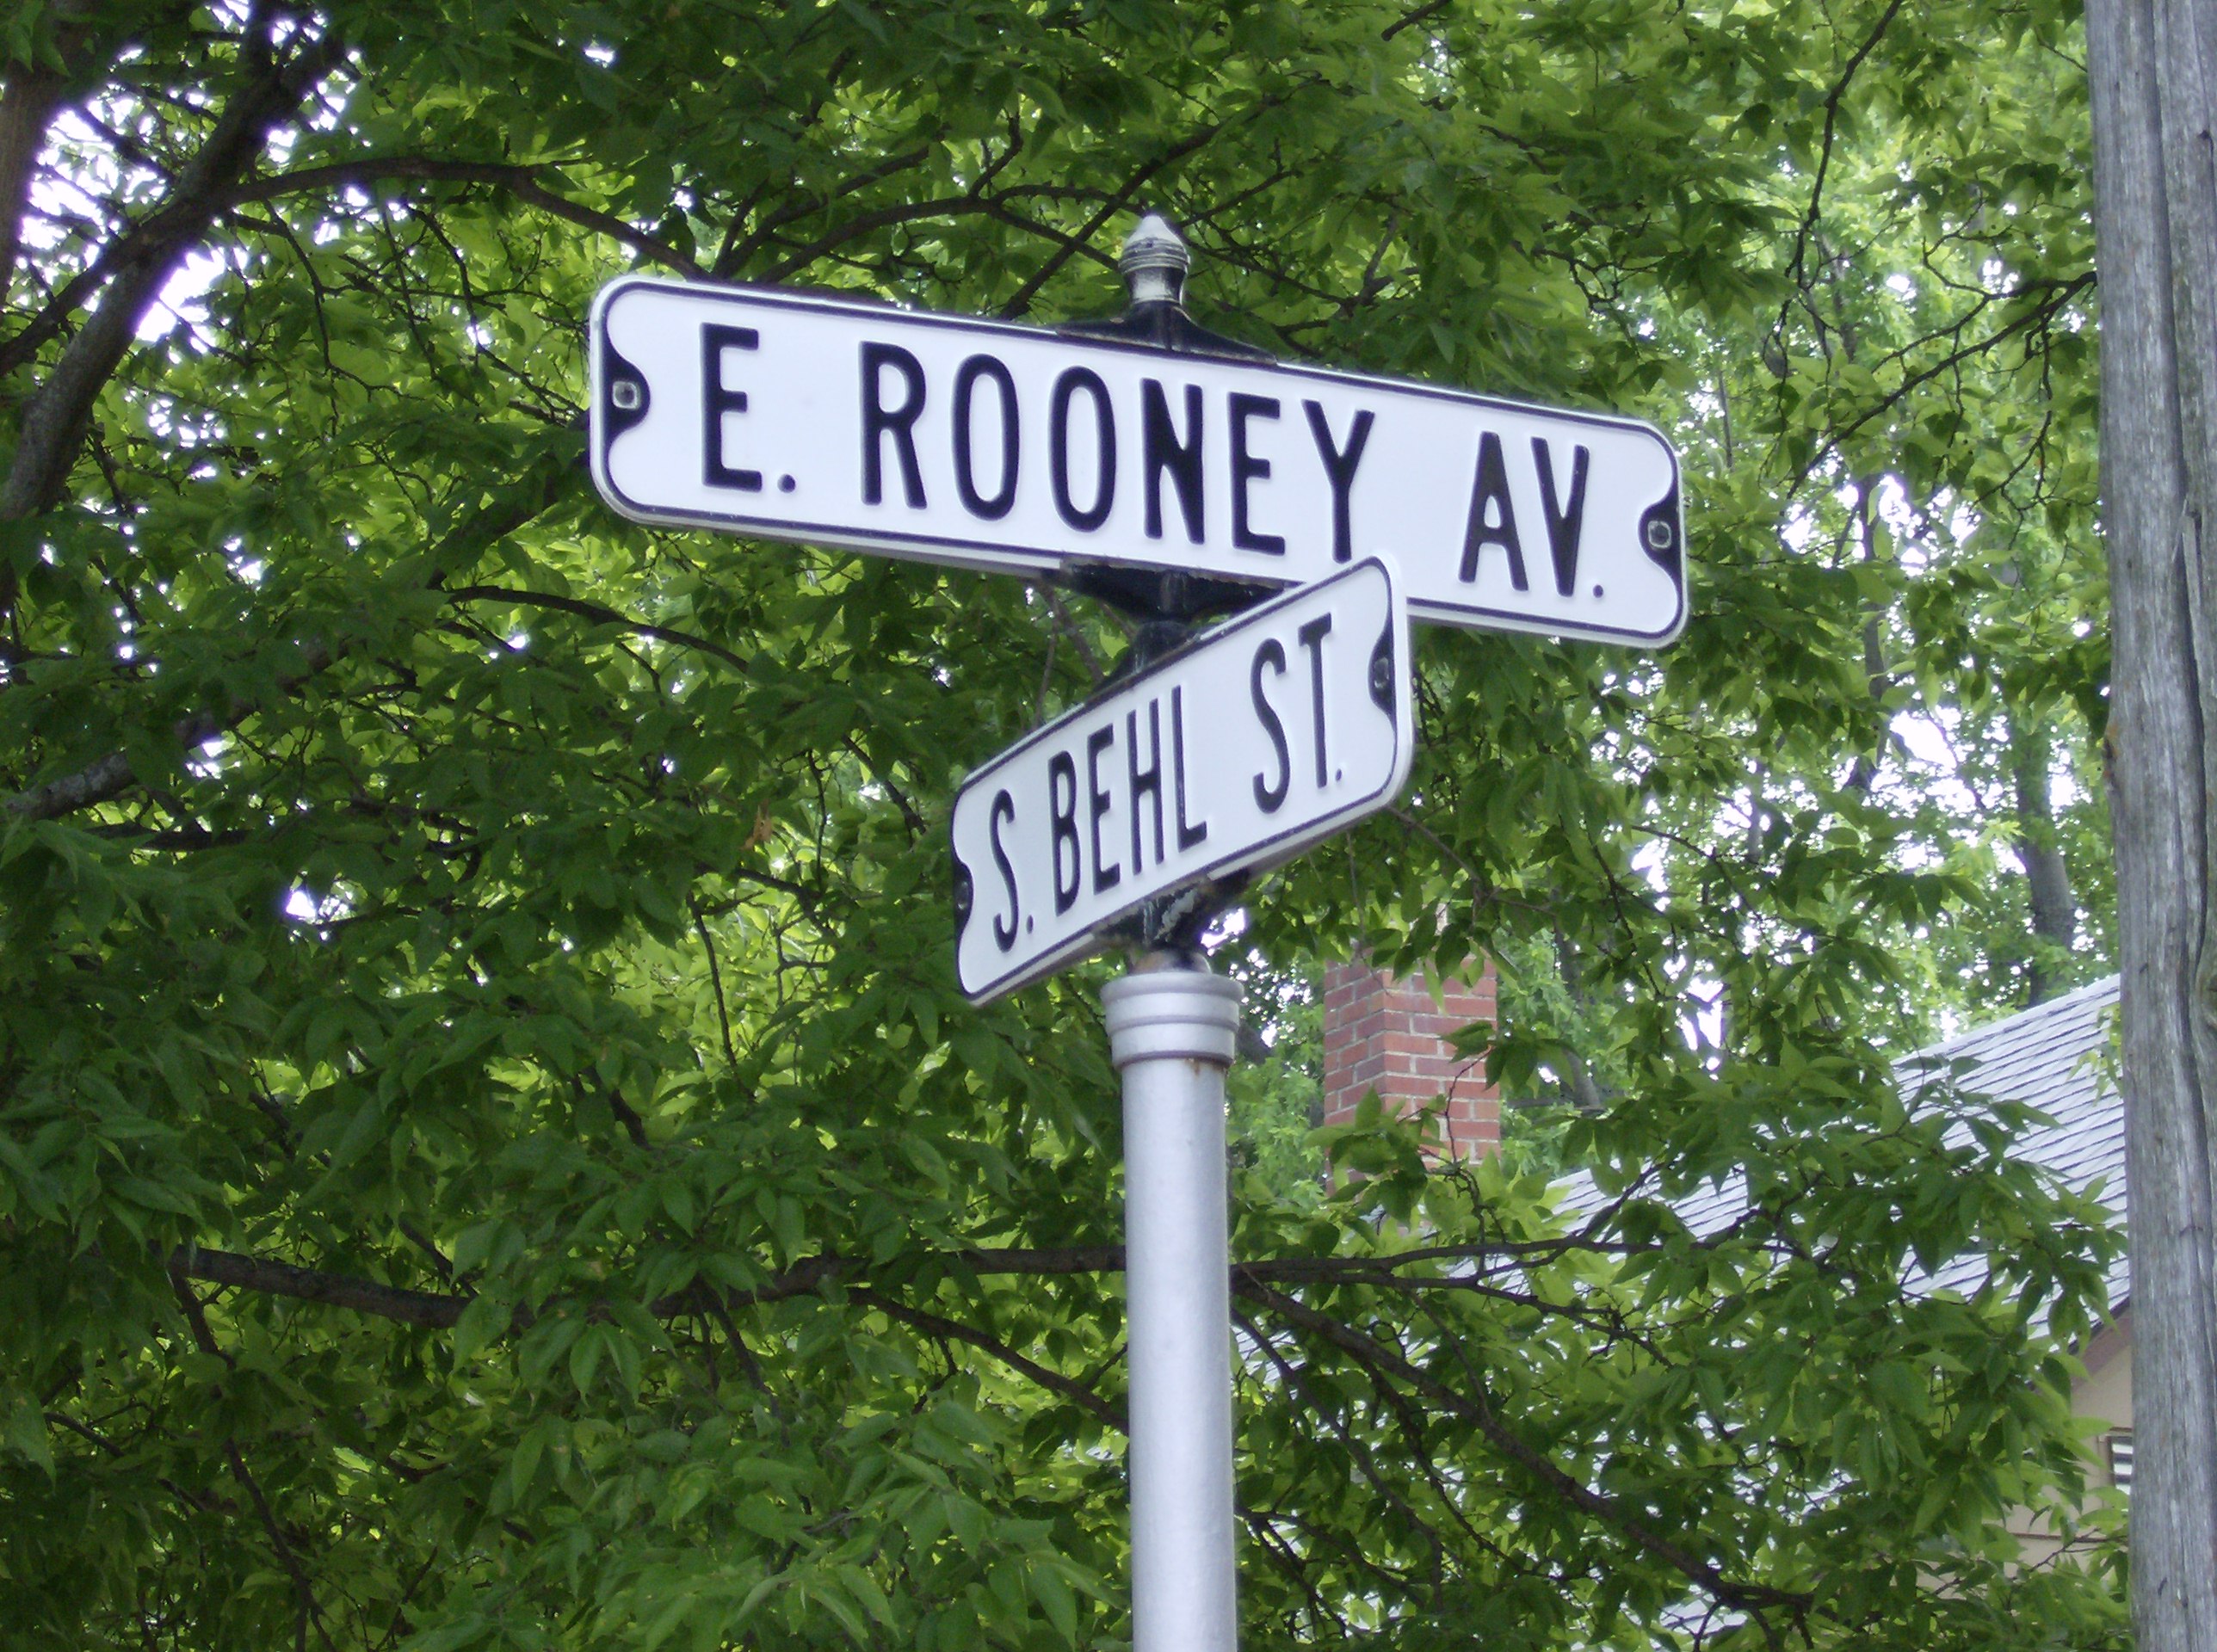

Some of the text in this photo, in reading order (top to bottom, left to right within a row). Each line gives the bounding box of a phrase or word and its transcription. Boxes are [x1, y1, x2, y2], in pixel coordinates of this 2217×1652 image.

[702, 322, 1605, 598] E. ROONEY AV.
[990, 612, 1343, 953] S. BEHL ST.
